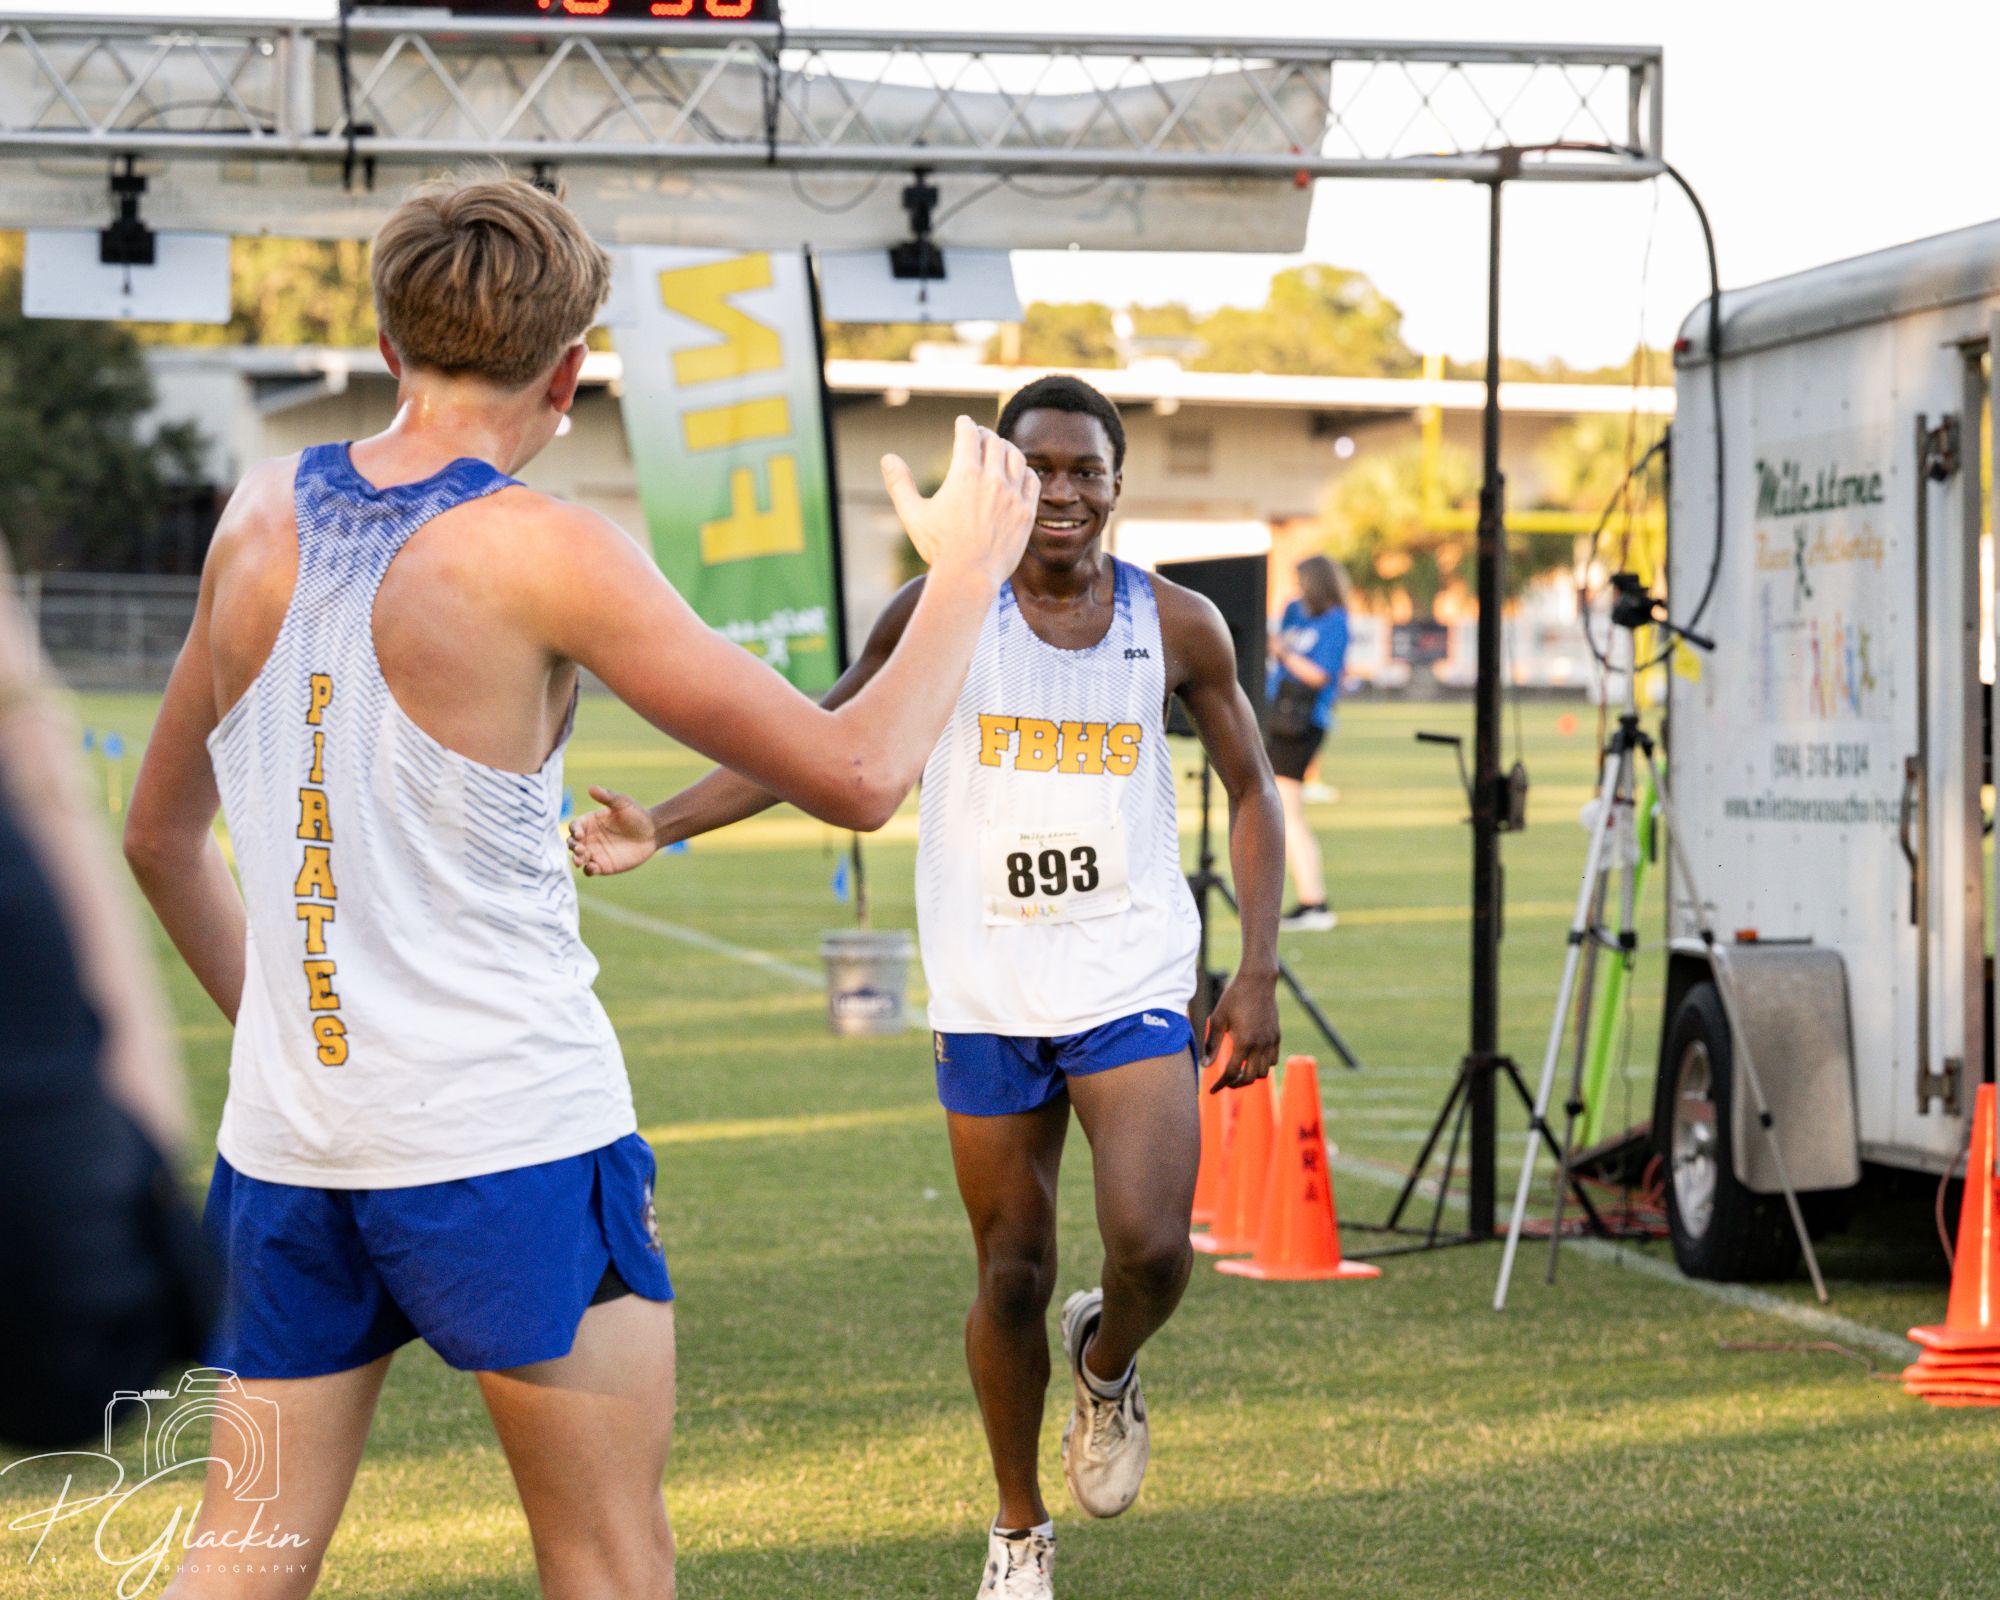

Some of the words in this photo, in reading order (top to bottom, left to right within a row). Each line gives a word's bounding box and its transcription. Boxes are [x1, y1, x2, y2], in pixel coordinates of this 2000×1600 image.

[1754, 459, 1884, 518] Milestone
[977, 712, 1144, 776] FBHS
[294, 673, 349, 1067] PIRATES
[1006, 846, 1099, 898] 893
